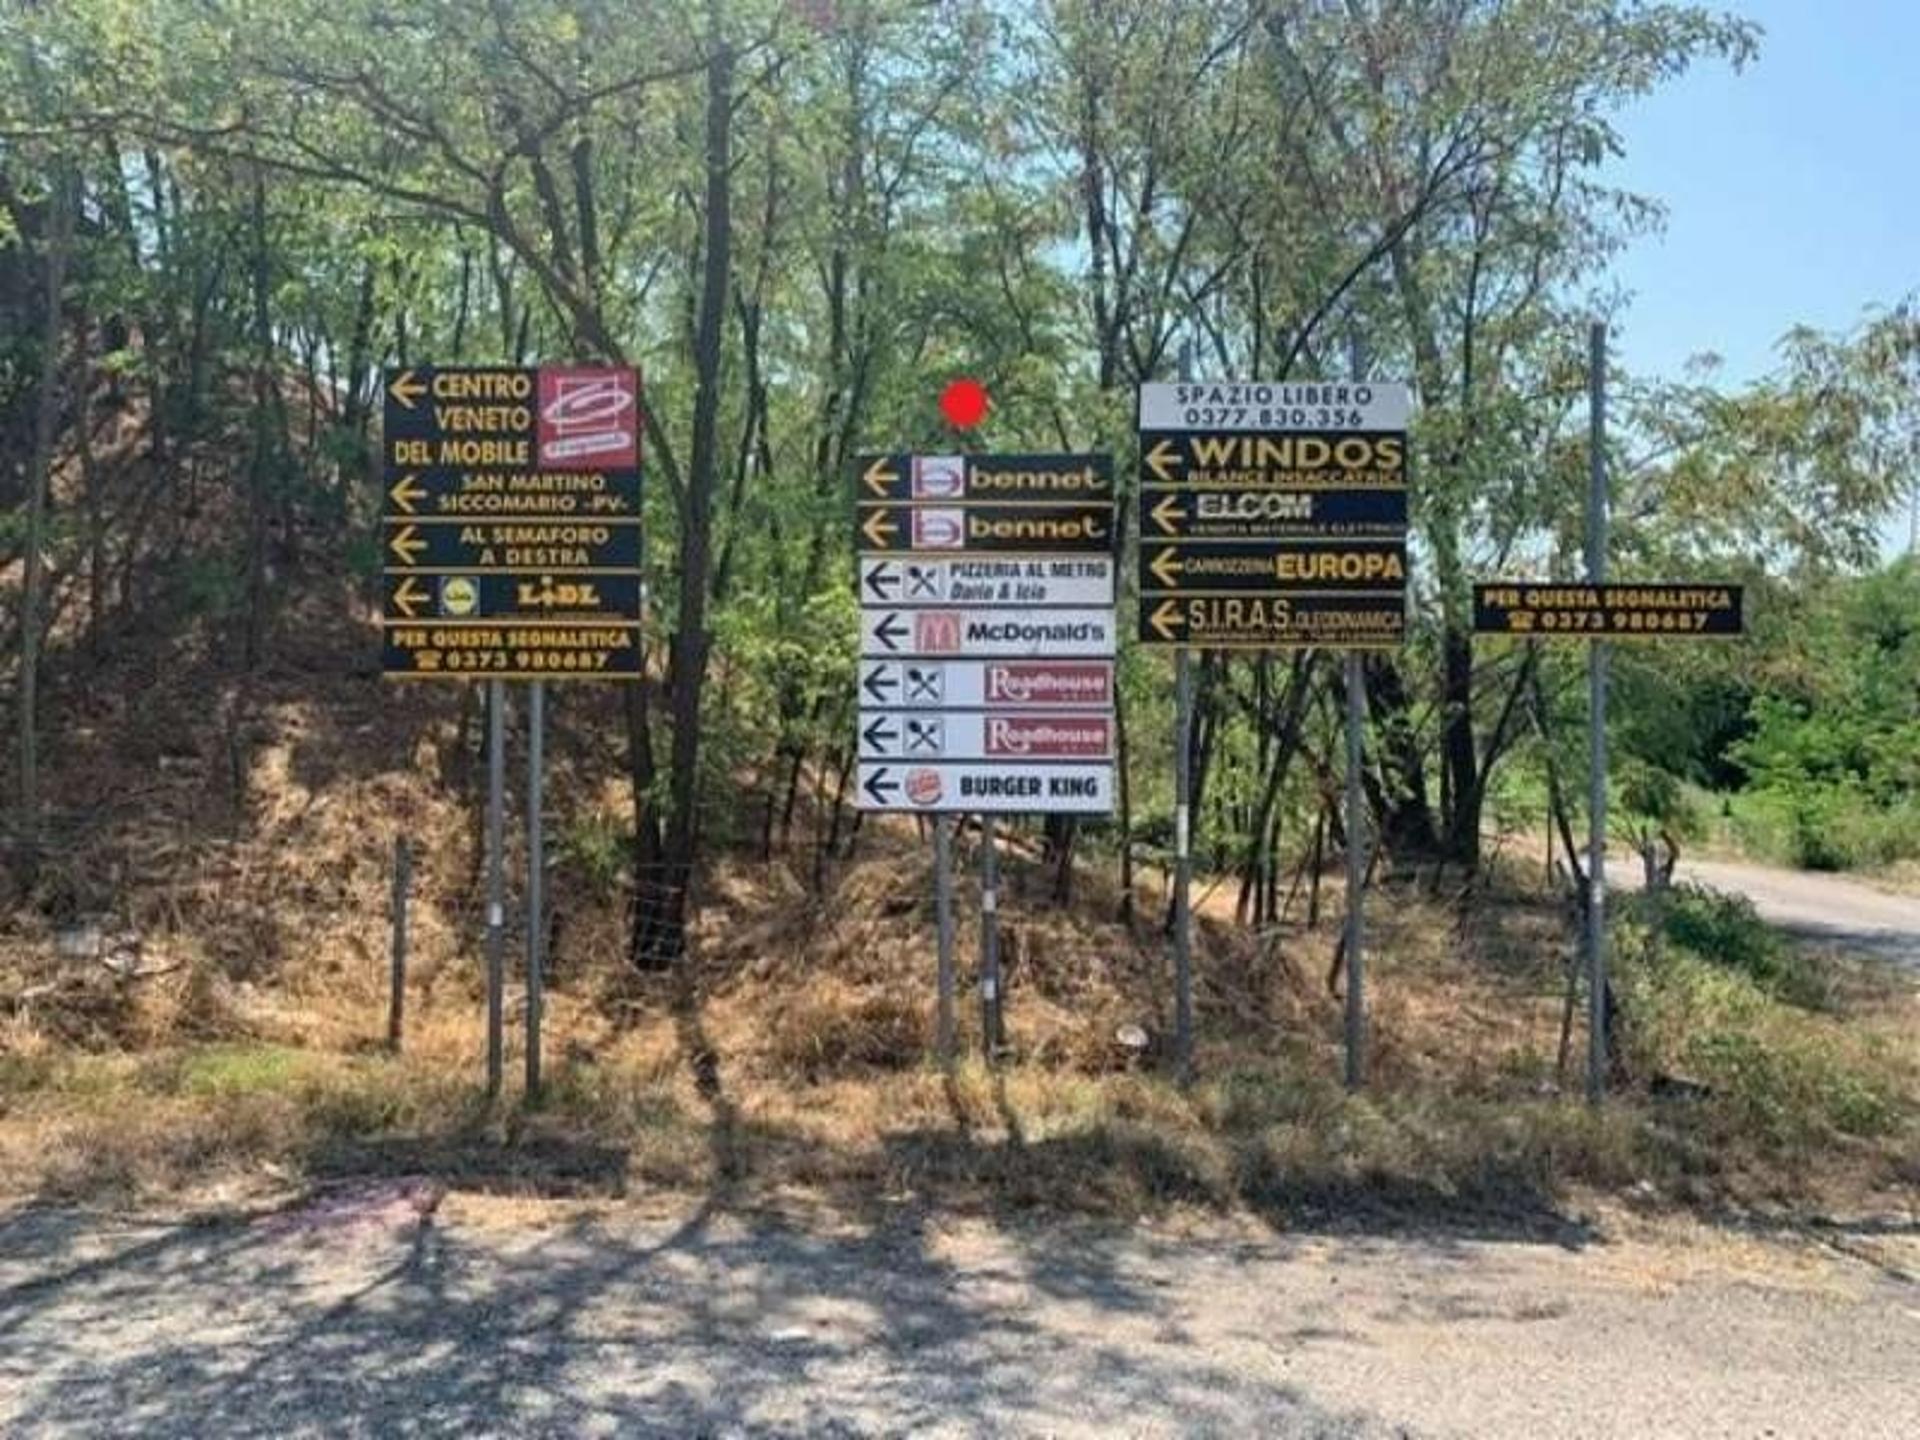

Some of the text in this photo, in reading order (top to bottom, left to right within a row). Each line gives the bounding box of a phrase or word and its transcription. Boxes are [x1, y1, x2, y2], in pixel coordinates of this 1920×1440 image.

[433, 374, 531, 398] CENTRO
[1177, 386, 1372, 406] SPAZIO LIBERO
[433, 407, 531, 431] VENETO
[395, 441, 529, 464] DEL MOBILE
[1189, 437, 1402, 468] WINDOS
[463, 475, 605, 490] SAN MARTINO
[970, 464, 1109, 490] bennet
[439, 494, 577, 511] SICCOMARIO
[1197, 493, 1313, 519] ELCOM
[460, 527, 609, 544] AL SEMAFORO
[970, 515, 1107, 539] bennet
[479, 549, 590, 565] A DESTRA
[1276, 553, 1403, 580] EUROPA
[950, 563, 1108, 578] PIZZERIA AL METRO
[1484, 589, 1731, 608] PER QUESTA SEGNALETICA
[1541, 611, 1604, 629] 0373
[394, 629, 632, 649] PER QUESTA SEGNALETICA
[968, 622, 1106, 642] McDonald's
[446, 651, 508, 669] 0373
[989, 668, 1105, 701] Roadhouse
[989, 719, 1105, 752] Roadhouse
[959, 776, 1042, 796] BURGER
[1047, 776, 1098, 796] KING
